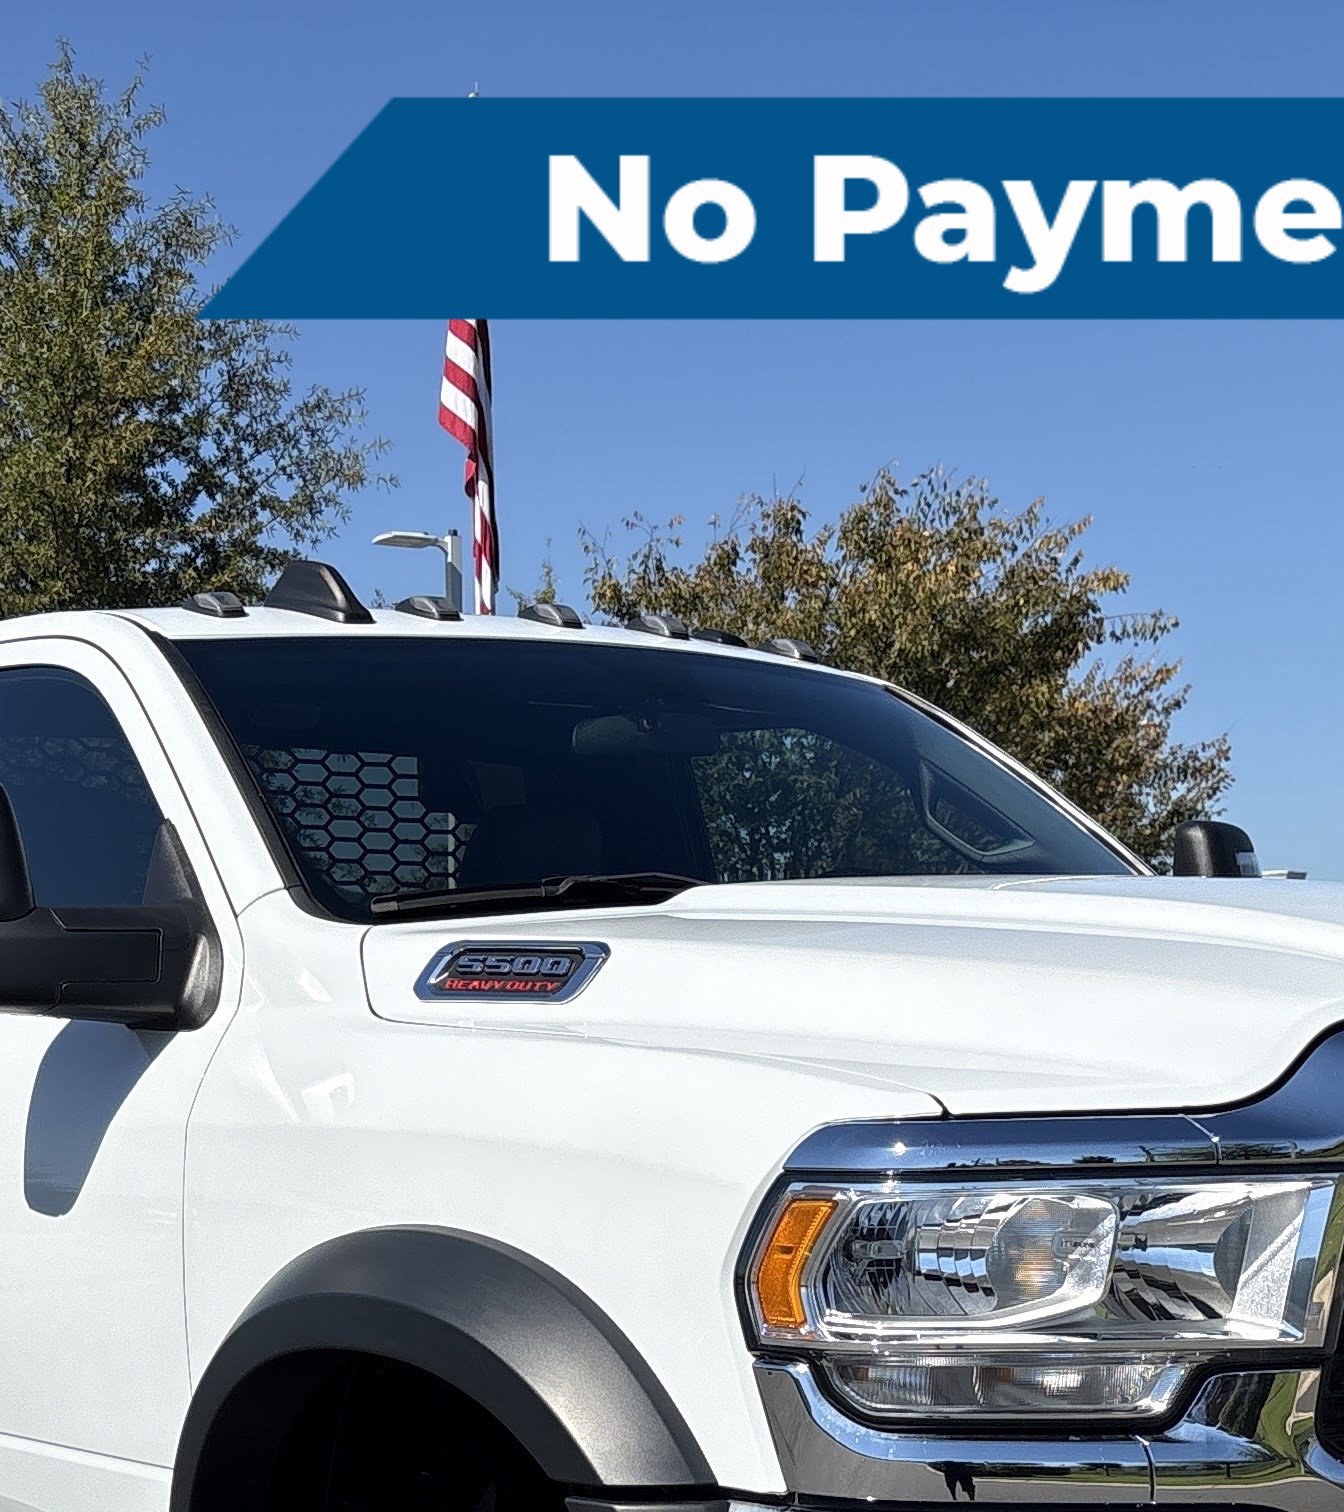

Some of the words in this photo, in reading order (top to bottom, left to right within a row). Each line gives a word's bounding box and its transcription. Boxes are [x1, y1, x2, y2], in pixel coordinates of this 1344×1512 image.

[455, 954, 574, 977] 5500
[443, 979, 503, 992] HEAVY
[505, 979, 562, 992] DUTY
